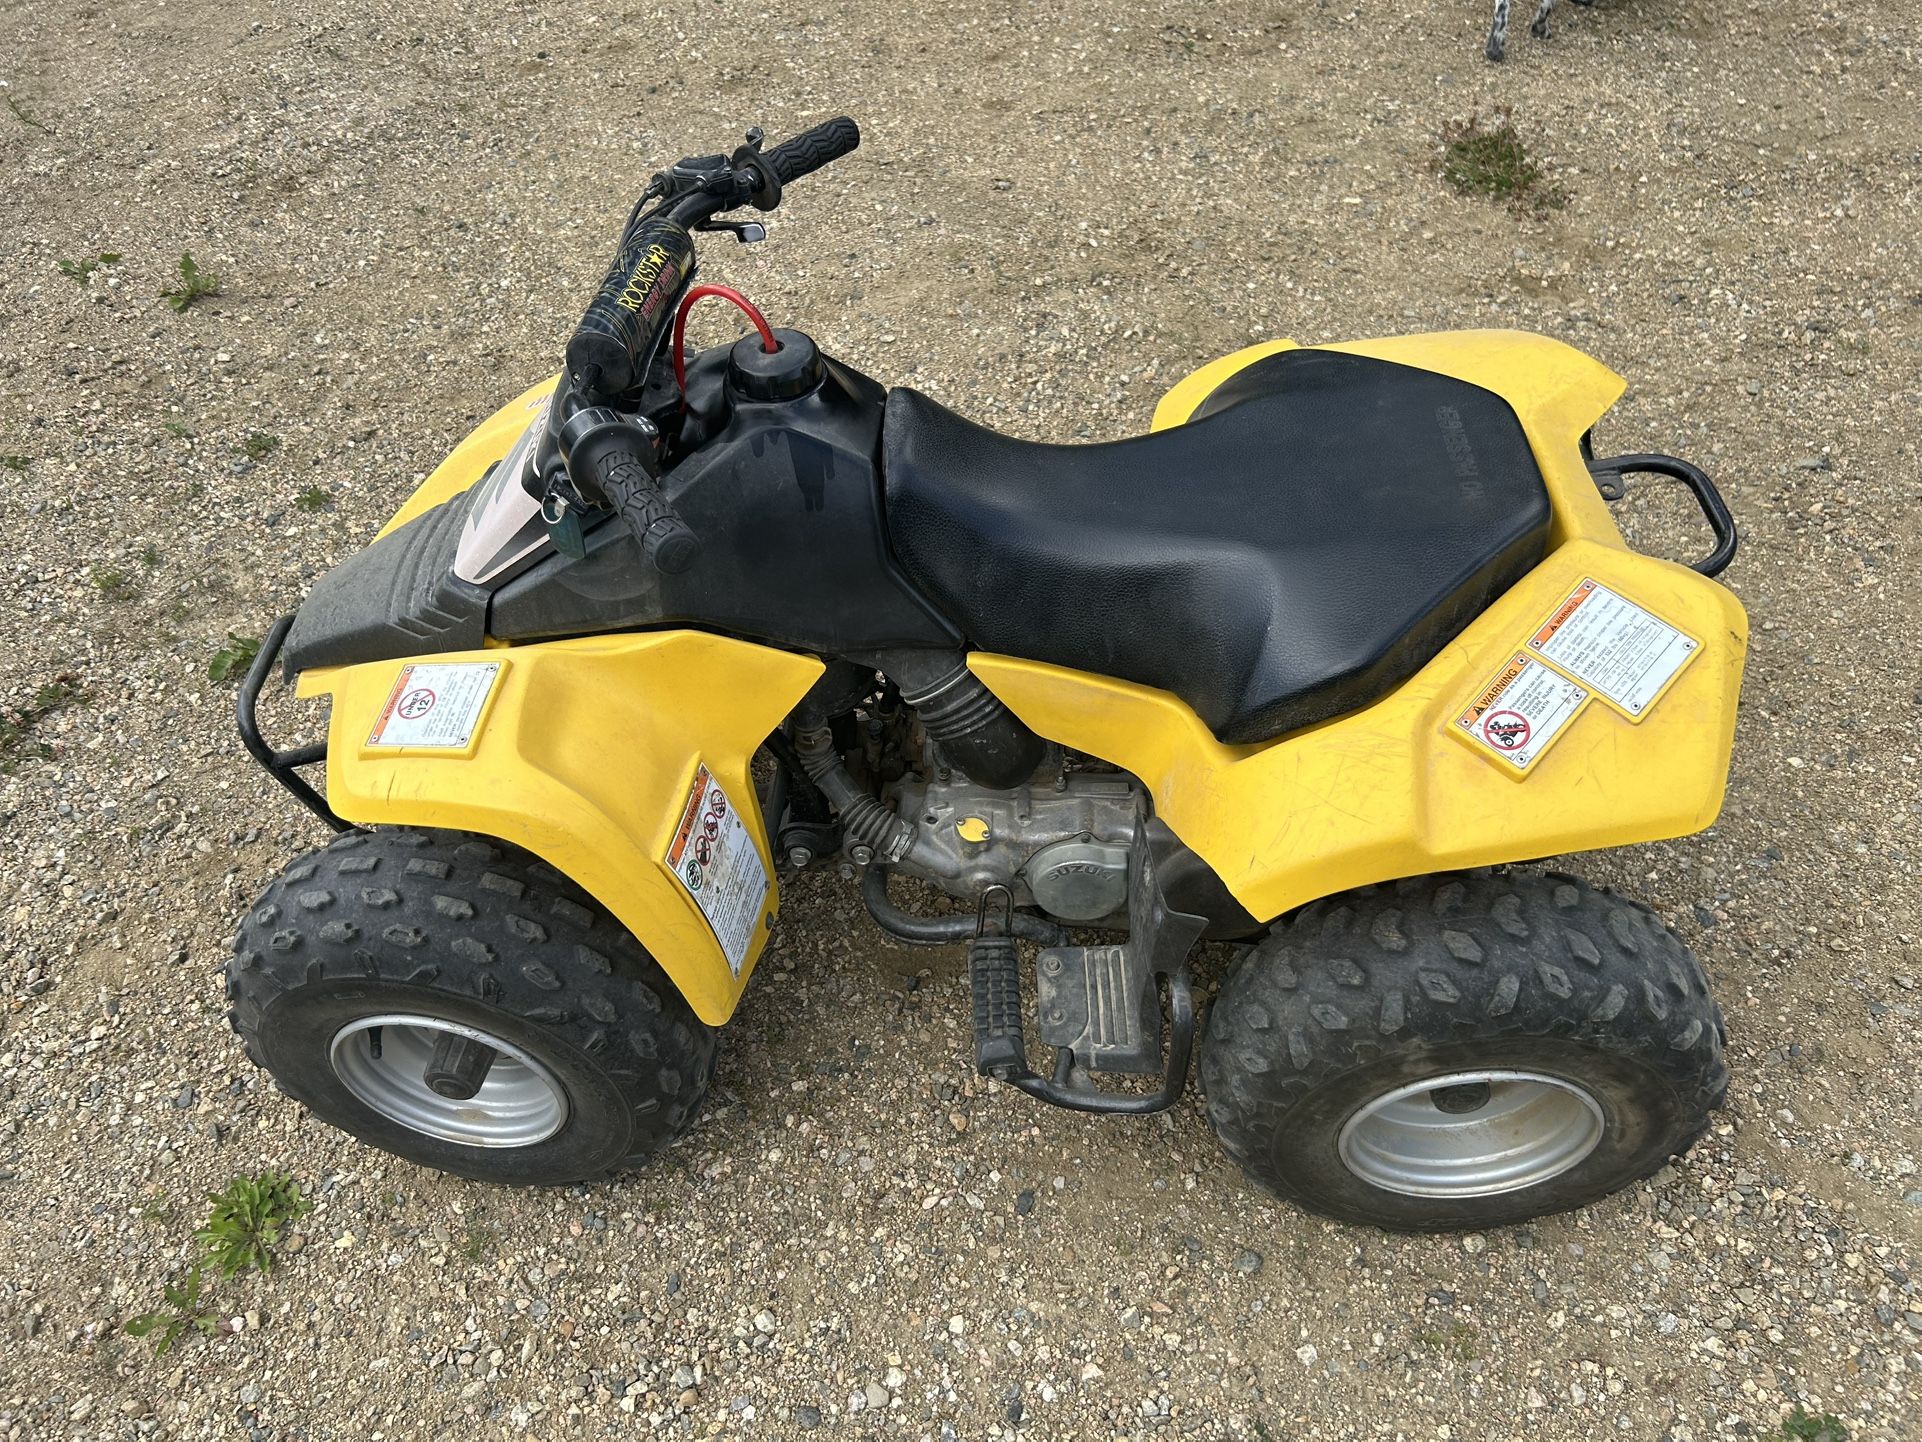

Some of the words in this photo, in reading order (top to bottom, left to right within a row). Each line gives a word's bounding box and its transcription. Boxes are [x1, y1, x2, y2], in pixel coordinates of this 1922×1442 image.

[1554, 601, 1578, 624] WARNING
[1568, 650, 1585, 666] ALWAYS
[1581, 660, 1596, 674] NEVER
[1478, 667, 1518, 707] WARNING
[1527, 680, 1536, 688] can
[1533, 668, 1546, 681] cause
[387, 688, 402, 713] WARNING
[406, 693, 421, 715] UNDER
[417, 699, 430, 711] 12
[1525, 699, 1542, 716] SEVERE
[1534, 699, 1550, 715] DEATH
[686, 793, 701, 831] WARNING
[1047, 863, 1116, 881] SUZUKI
